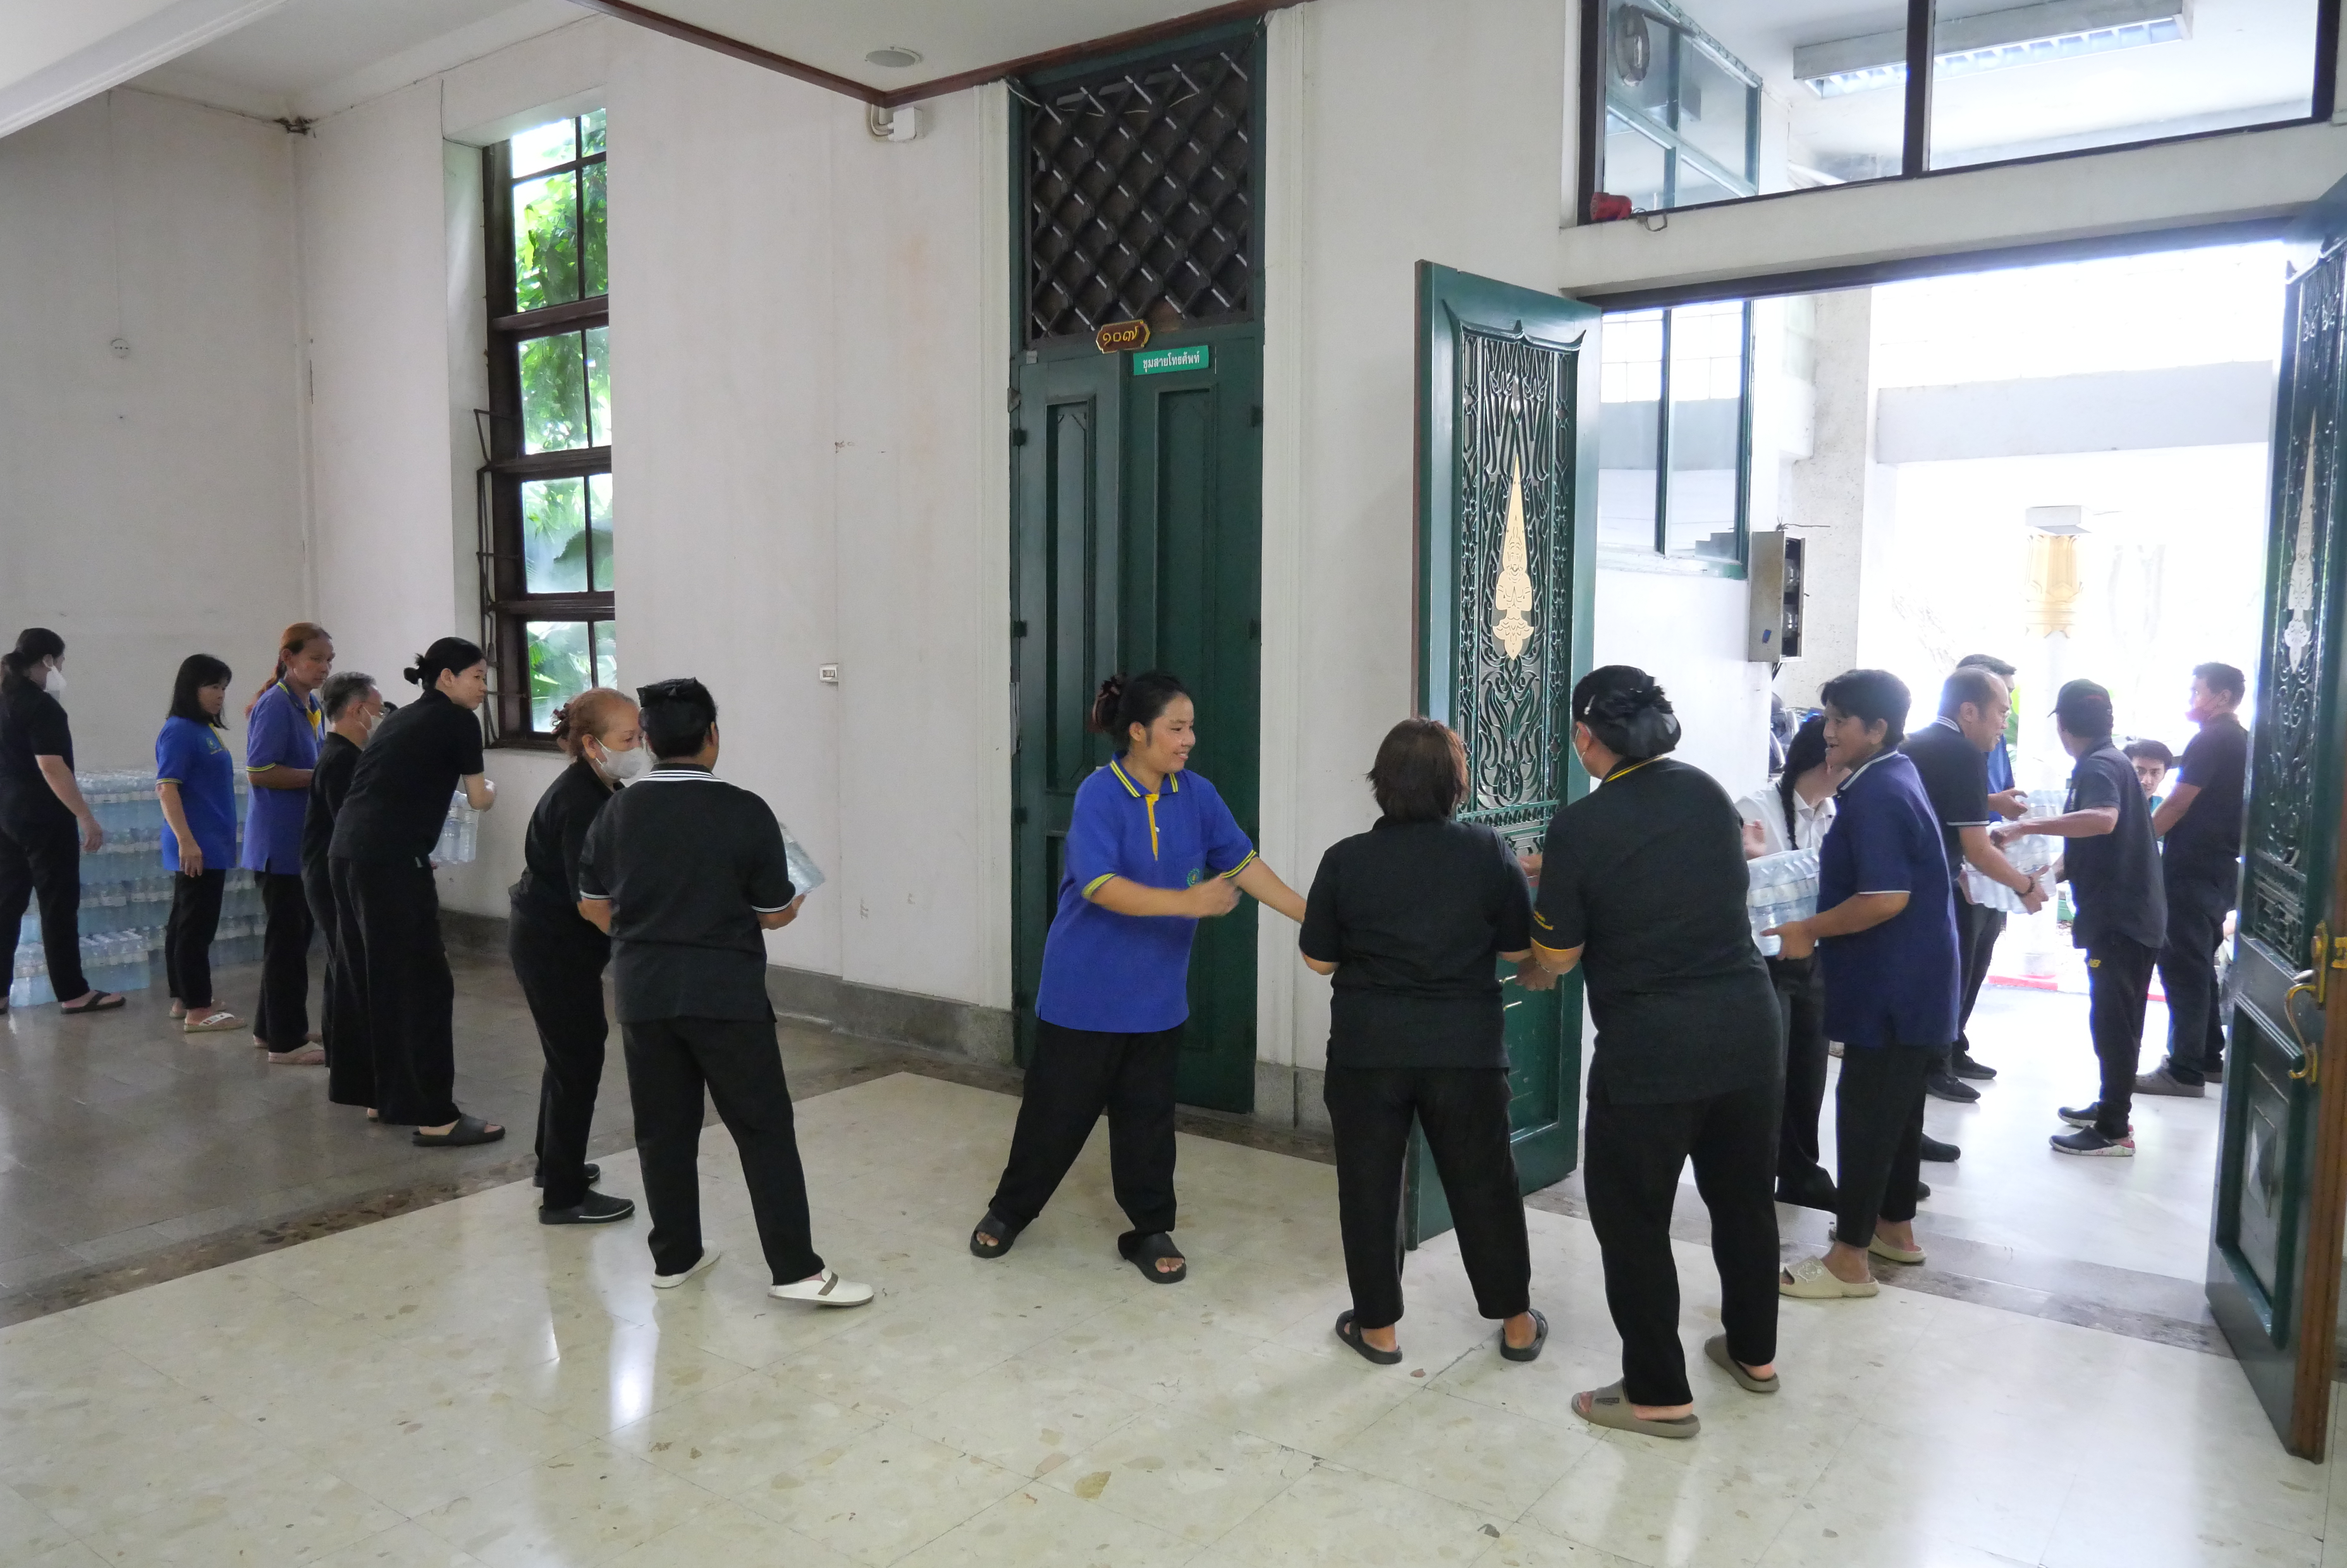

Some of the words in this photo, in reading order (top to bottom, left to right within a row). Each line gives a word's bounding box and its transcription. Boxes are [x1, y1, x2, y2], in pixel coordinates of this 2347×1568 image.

[1103, 326, 1137, 346] ๑๐๗
[1143, 351, 1199, 372] ชุมสายโทรศัพท์
